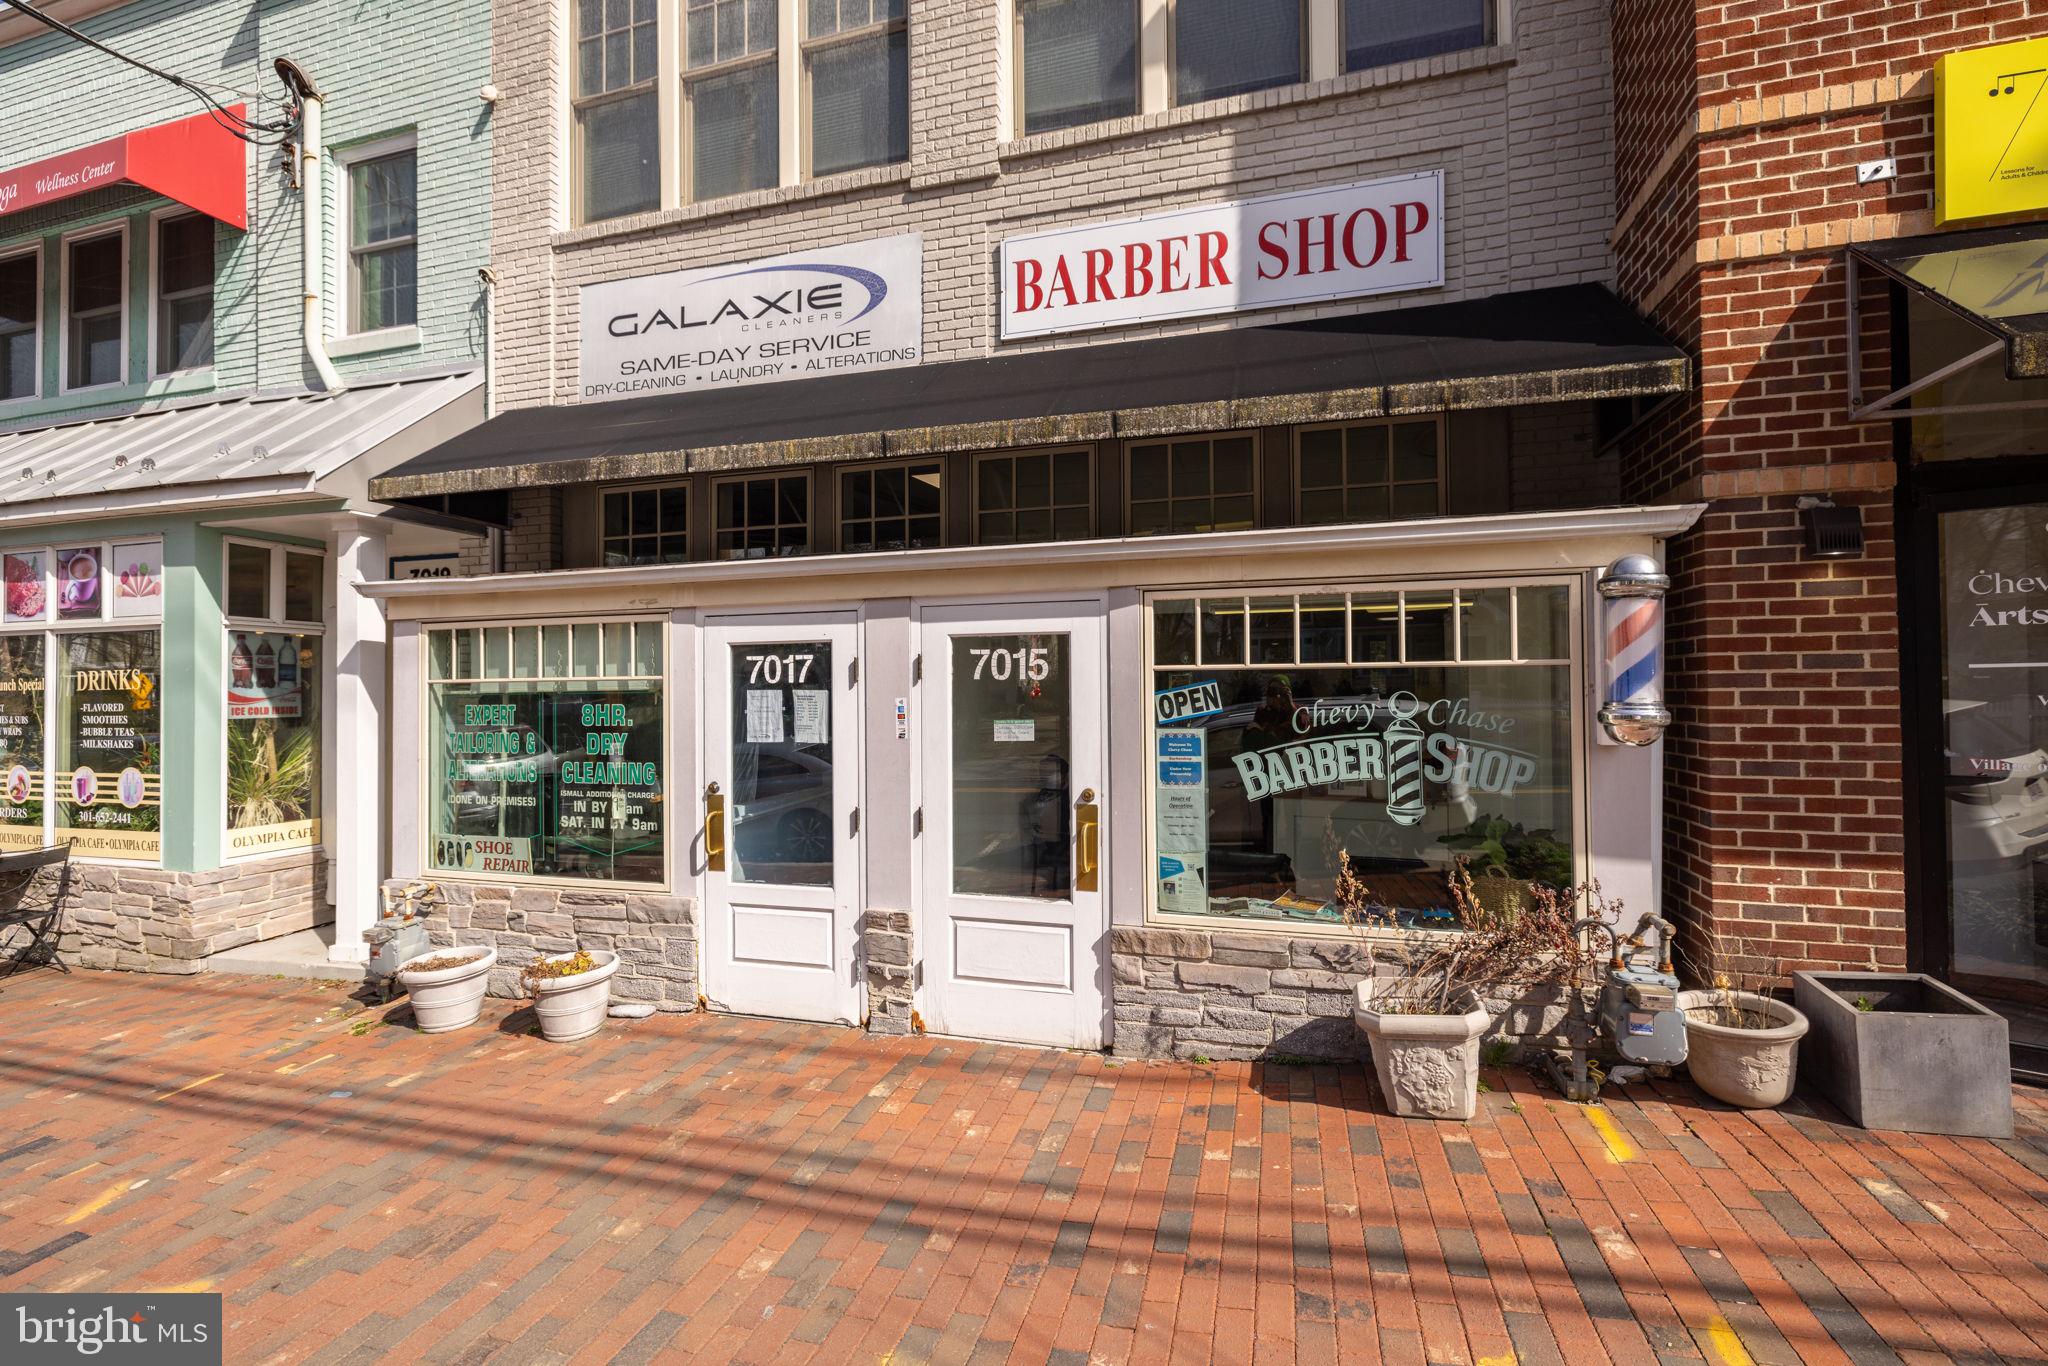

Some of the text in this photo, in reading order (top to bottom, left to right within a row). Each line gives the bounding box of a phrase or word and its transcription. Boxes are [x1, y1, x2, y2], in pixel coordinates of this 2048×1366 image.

[36, 159, 116, 195] Wellness Center
[1012, 200, 1429, 313] BARBER SHOP
[607, 283, 842, 338] GALAXIE
[741, 311, 842, 332] CLEANERS
[620, 330, 871, 375] SAME-DAY SERVICE
[585, 347, 916, 397] DRY-CLEANING LAUNDRY ALTERATIONS
[746, 654, 813, 684] 7017
[969, 648, 1048, 681] 7015
[18, 678, 45, 694] Special
[76, 669, 141, 692] DRINKS
[80, 703, 124, 712] -FLAVORED
[232, 706, 298, 716] ICE COLD INSIDE
[1158, 684, 1221, 720] OPEN
[14, 716, 29, 724] SUBS
[82, 715, 128, 725] SMOOTHIES
[465, 704, 516, 726] EXPERT
[582, 703, 633, 727] 8HR.
[1291, 698, 1516, 735] Chevy Chase
[3, 728, 22, 736] WRAPS
[80, 728, 135, 736] -BUBBLE TEAS
[80, 740, 134, 749] -MILKSHAKES
[449, 732, 536, 754] TAILORING &
[586, 733, 628, 755] DRY
[562, 761, 656, 785] CLEANING
[1232, 733, 1537, 802] BARBER SHOP
[476, 795, 488, 805] ON
[574, 800, 587, 813] IN
[592, 802, 608, 813] BY
[78, 811, 132, 824] 301-652-2441
[560, 815, 587, 828] SAT.
[592, 816, 605, 829] IN
[632, 818, 658, 831] 9am
[28, 834, 44, 846] CAFE
[88, 838, 105, 849] CAFE
[109, 838, 140, 851] OLYMPIA
[141, 840, 160, 852] CAFE
[233, 826, 316, 848] OLYMPIA CAFE
[475, 840, 513, 855] SHOE
[483, 857, 530, 874] REPAIR
